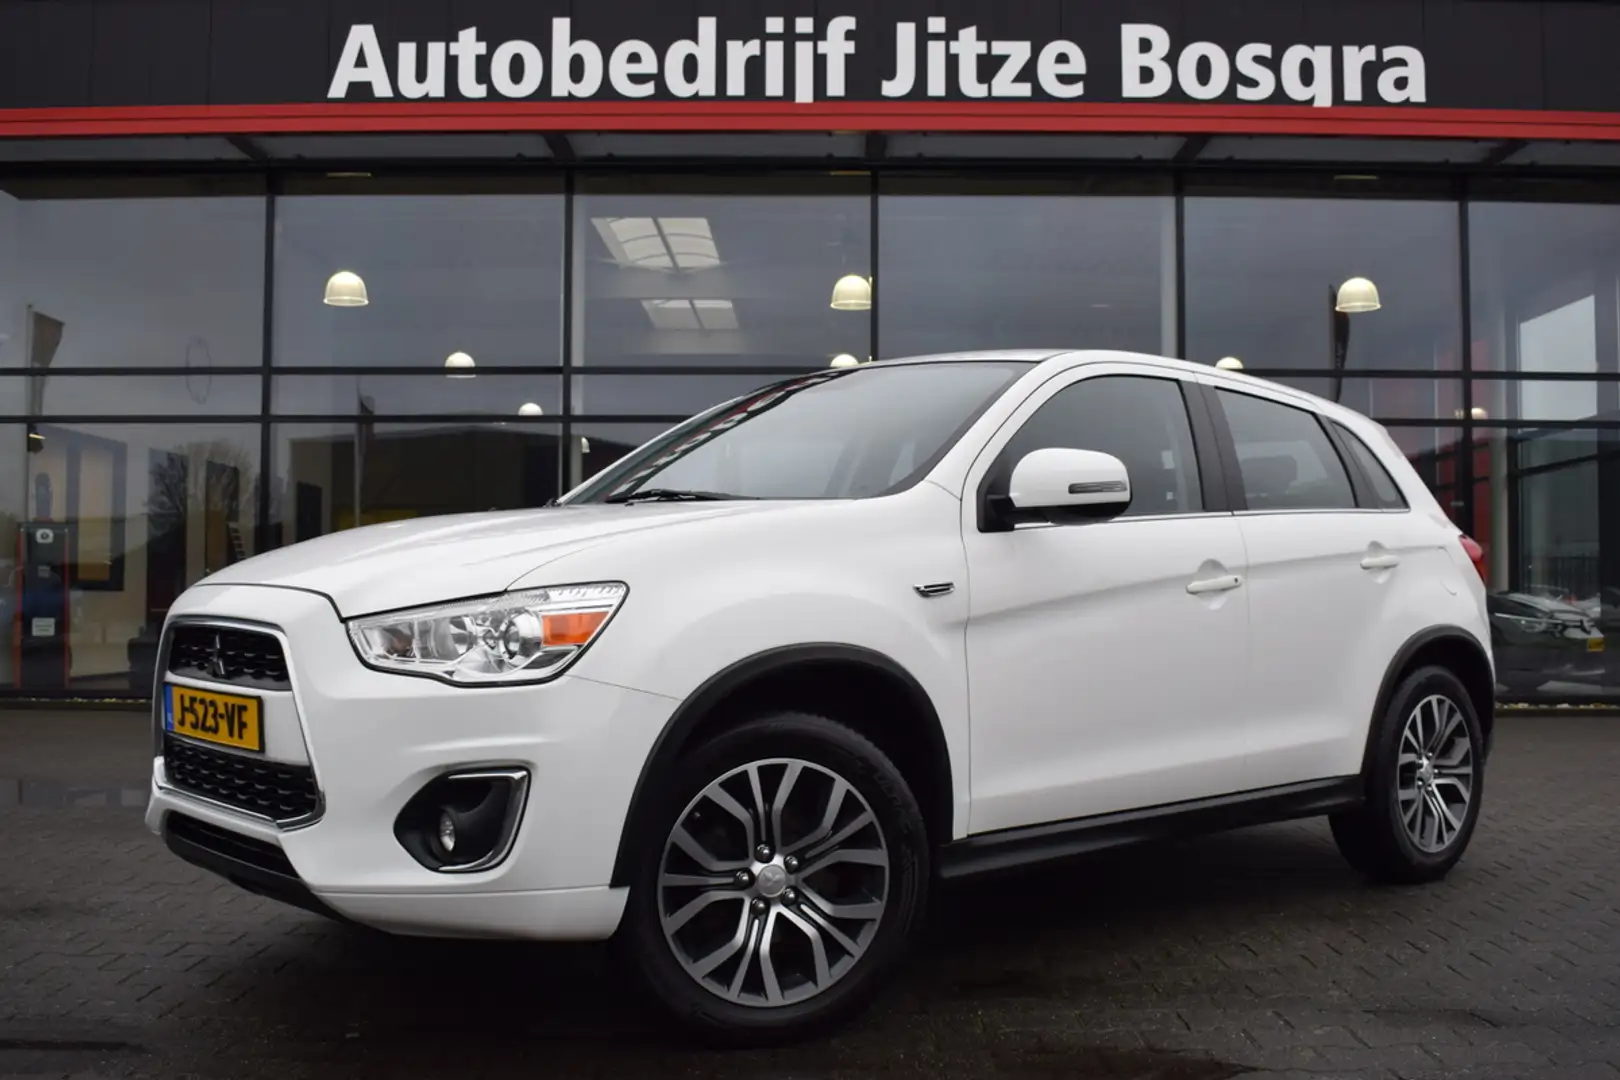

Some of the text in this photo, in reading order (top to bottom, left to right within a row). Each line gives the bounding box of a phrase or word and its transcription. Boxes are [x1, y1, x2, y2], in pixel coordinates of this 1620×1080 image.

[328, 16, 856, 104] Autobedrijf
[881, 16, 1087, 98] Jitze
[178, 693, 248, 740] J-523-VF
